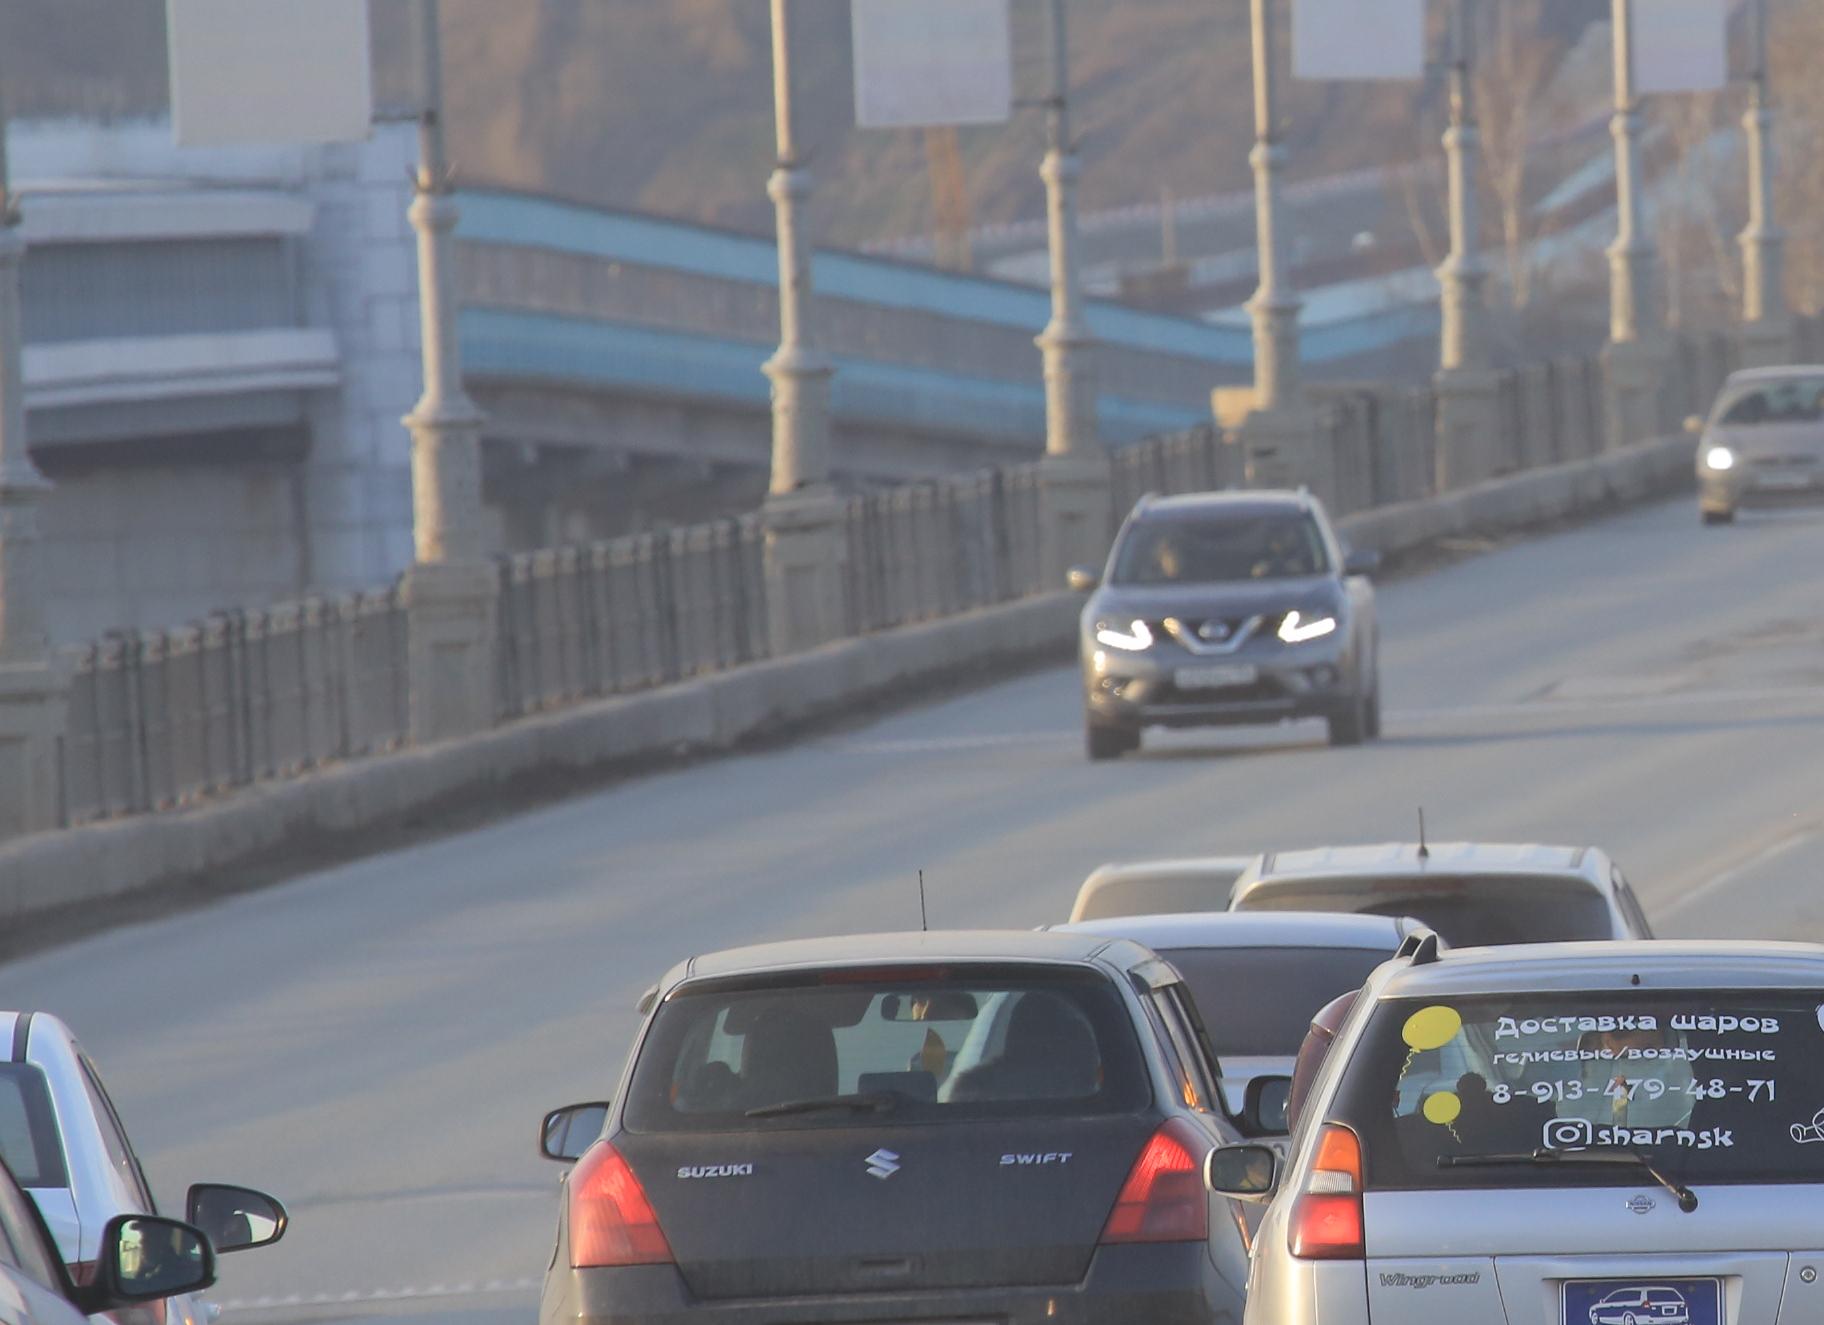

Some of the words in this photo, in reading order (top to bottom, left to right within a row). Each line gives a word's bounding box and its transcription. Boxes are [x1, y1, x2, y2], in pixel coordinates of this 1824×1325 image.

[1495, 1015, 1657, 1040] Доставка
[1492, 1078, 1776, 1104] 8-913-479-48-71
[1596, 1125, 1734, 1149] sharnsk
[999, 1152, 1073, 1165] SWIFT
[677, 1163, 753, 1179] SUZUKI
